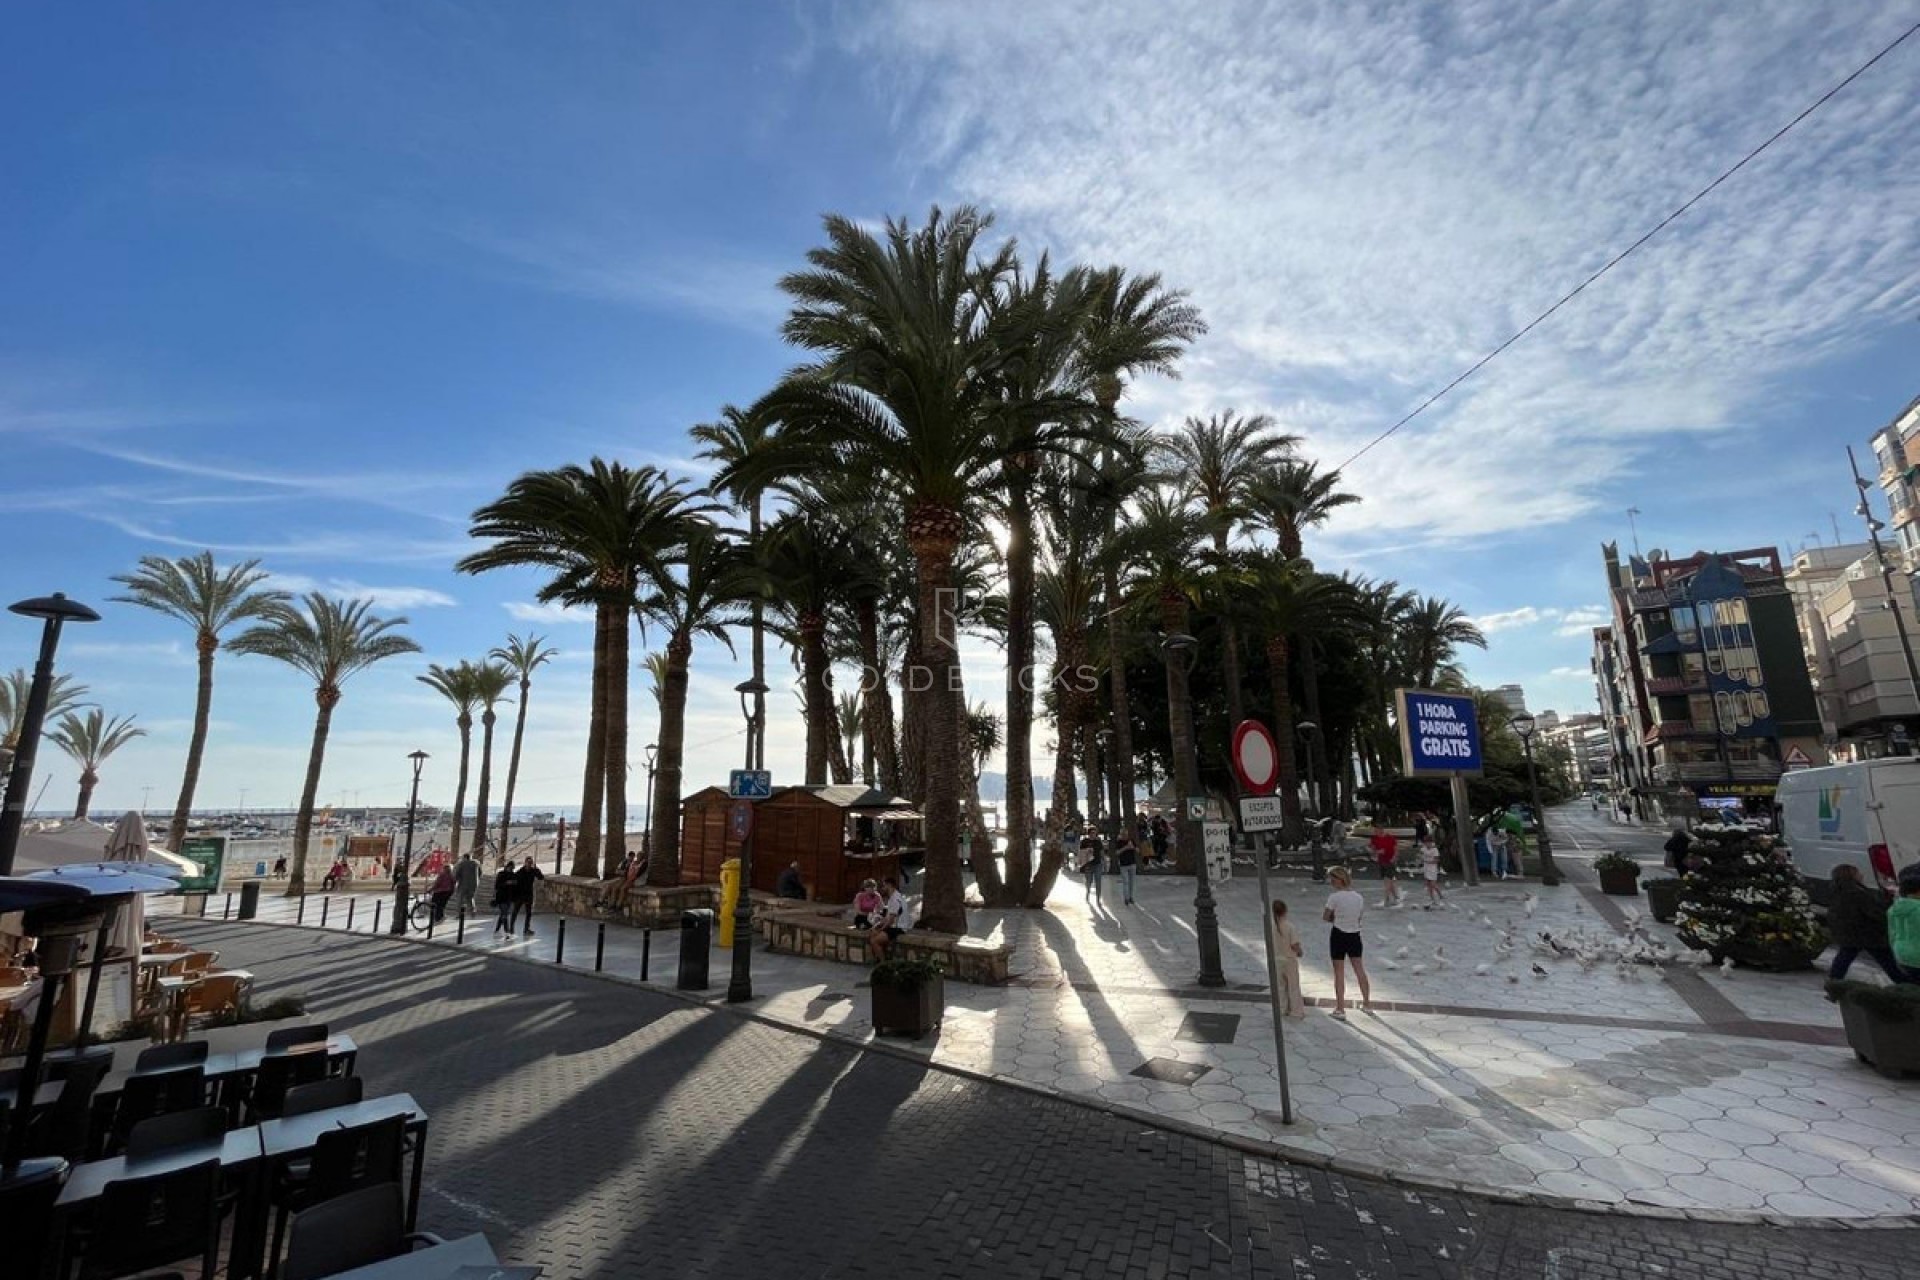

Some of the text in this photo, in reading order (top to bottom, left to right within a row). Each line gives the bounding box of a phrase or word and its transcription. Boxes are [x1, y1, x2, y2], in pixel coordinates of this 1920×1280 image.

[1416, 702, 1457, 719] 1 HORA
[1420, 720, 1468, 737] PARKING
[1421, 737, 1472, 758] GRATIS
